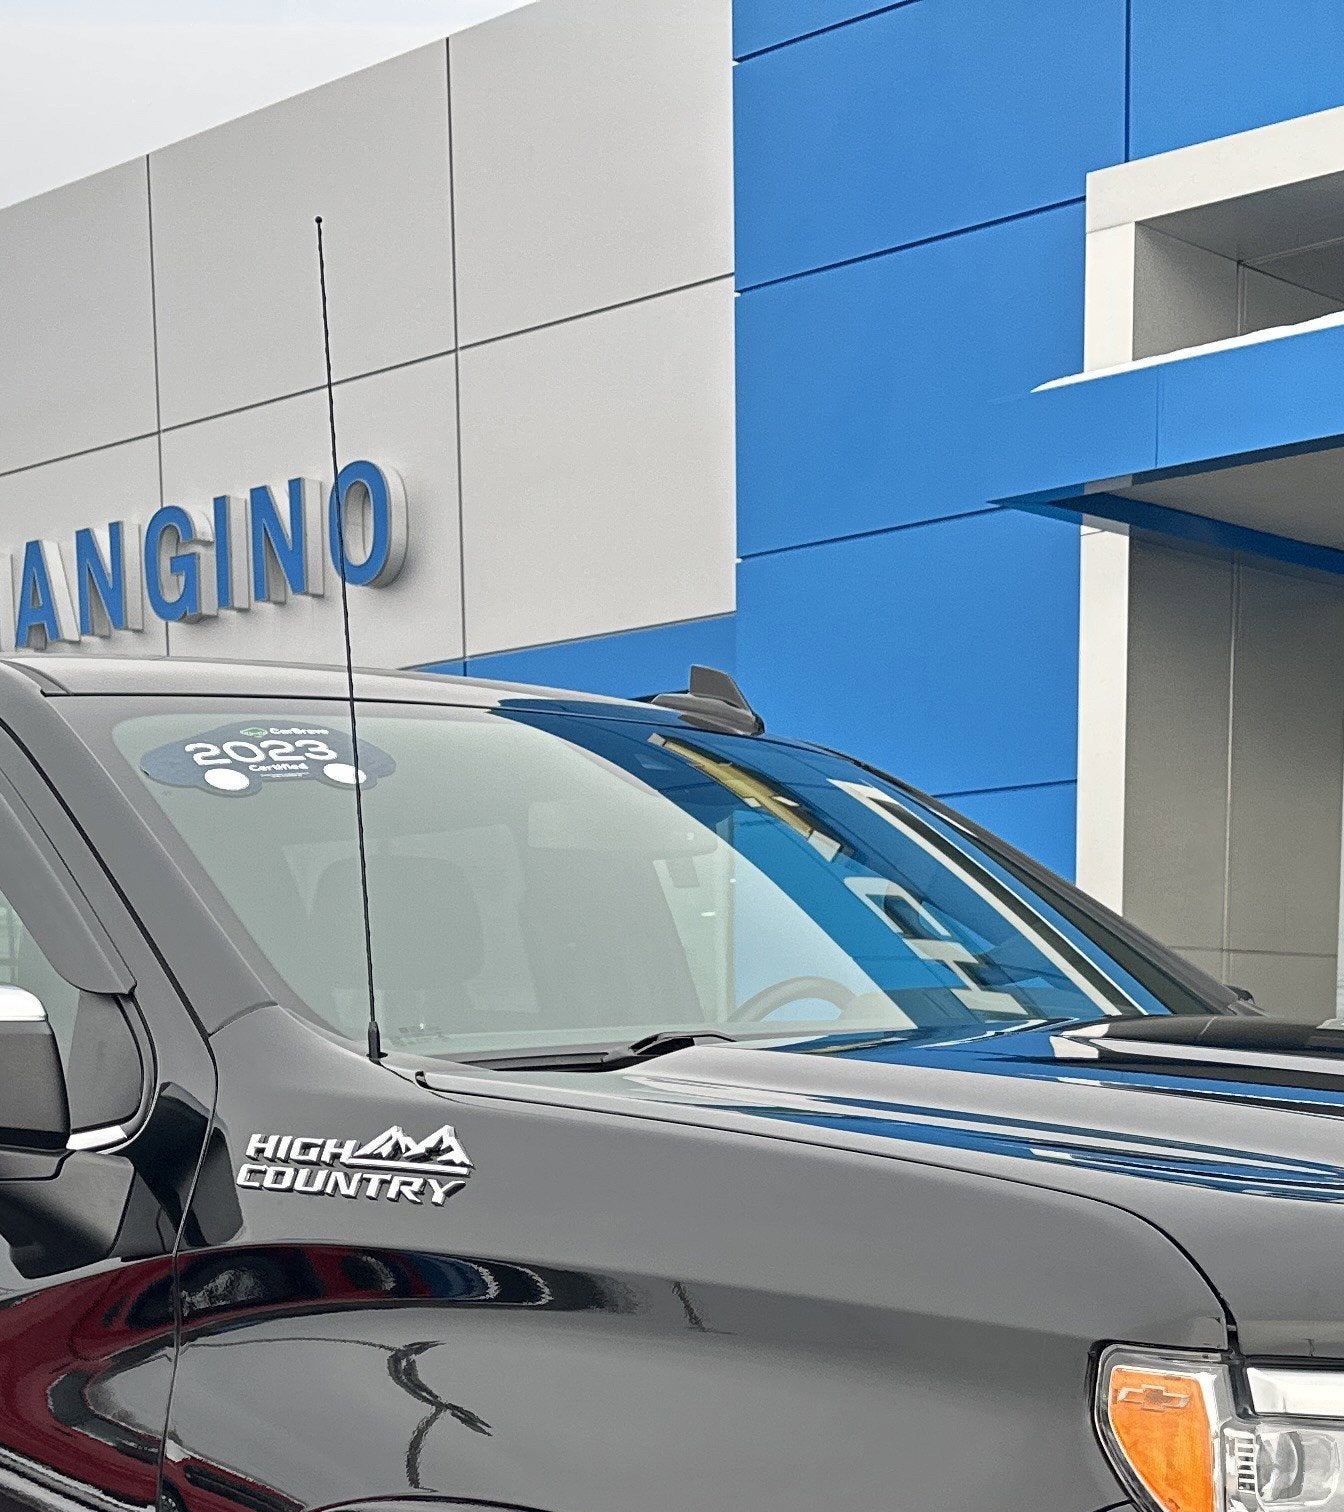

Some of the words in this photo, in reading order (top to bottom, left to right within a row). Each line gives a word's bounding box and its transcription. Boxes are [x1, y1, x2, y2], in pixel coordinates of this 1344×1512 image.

[184, 739, 338, 767] 2023
[245, 1133, 360, 1168] HIGH
[236, 1163, 467, 1208] COUNTRY
